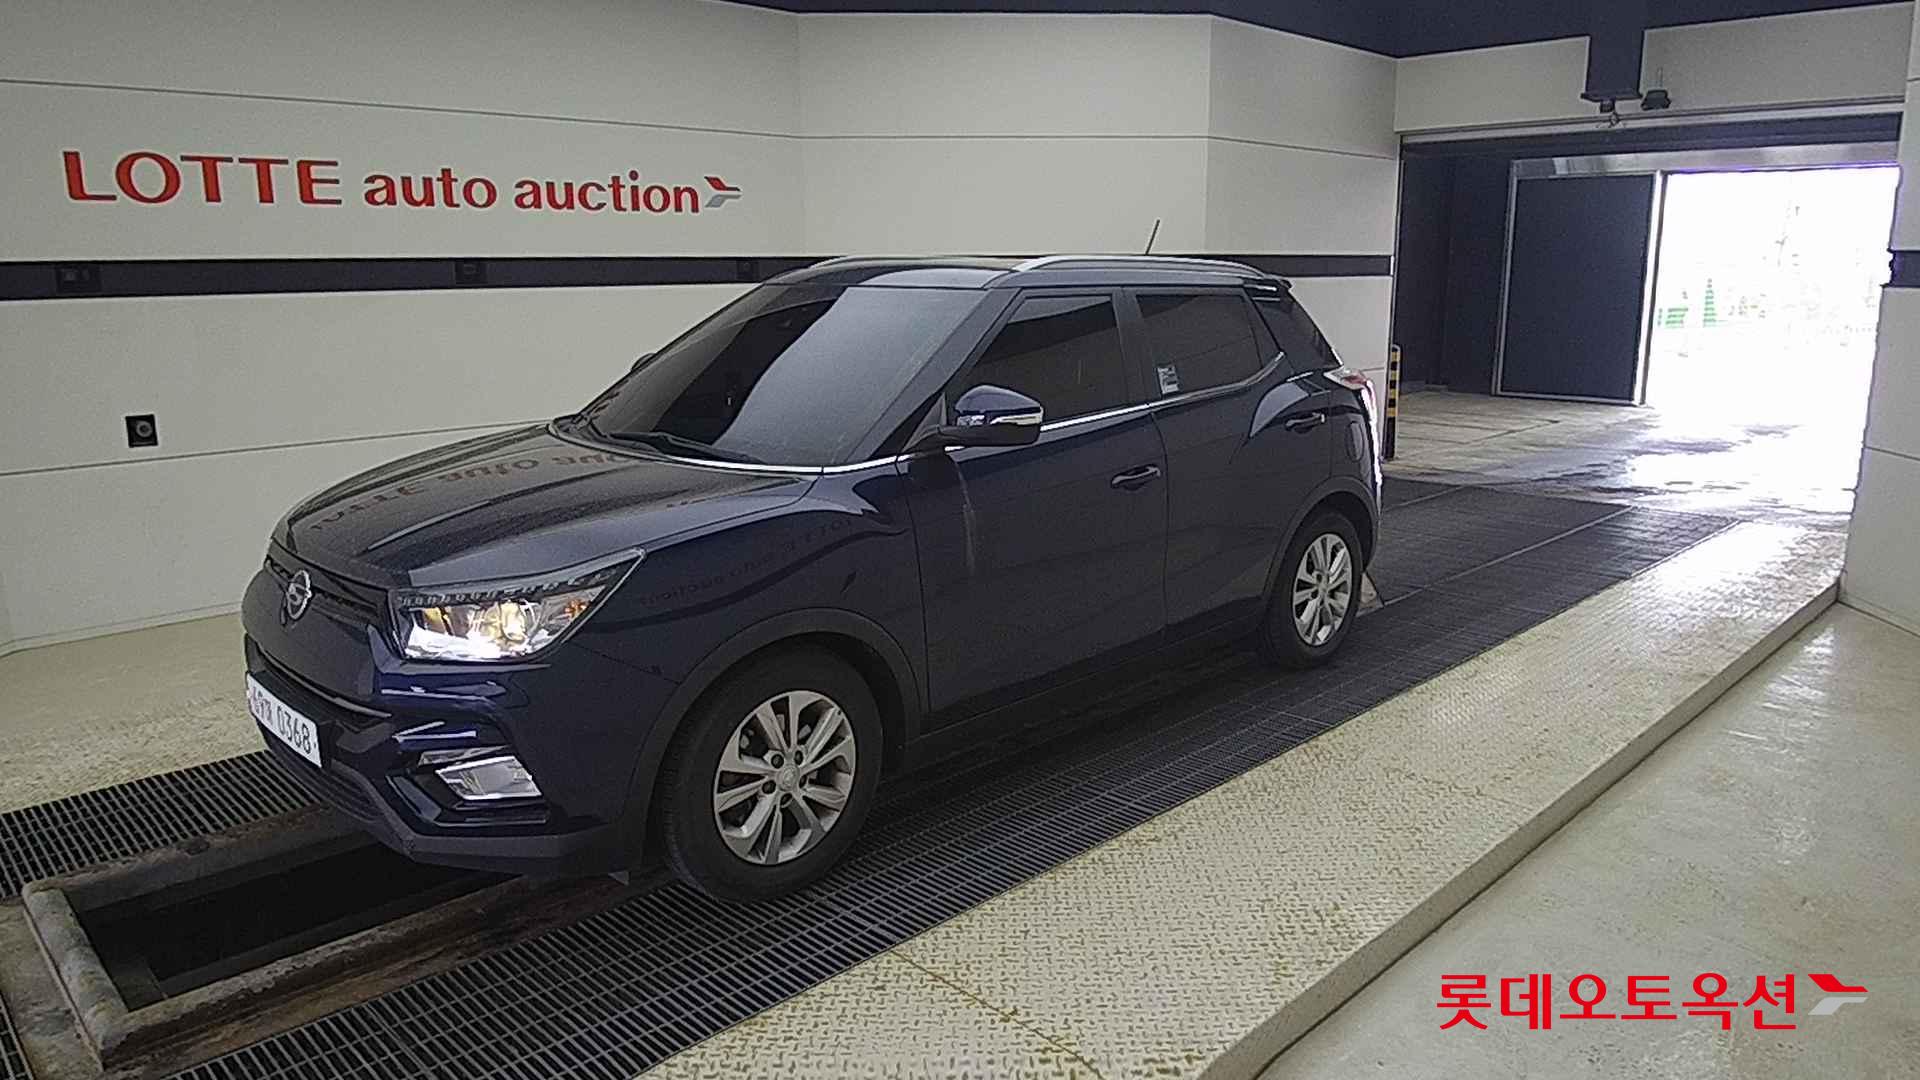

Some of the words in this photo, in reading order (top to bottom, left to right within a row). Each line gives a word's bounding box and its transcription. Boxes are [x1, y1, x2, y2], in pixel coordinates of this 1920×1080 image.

[63, 150, 342, 207] LOTTE
[363, 167, 498, 210] auto
[513, 169, 700, 214] auction
[277, 705, 312, 754] 0368
